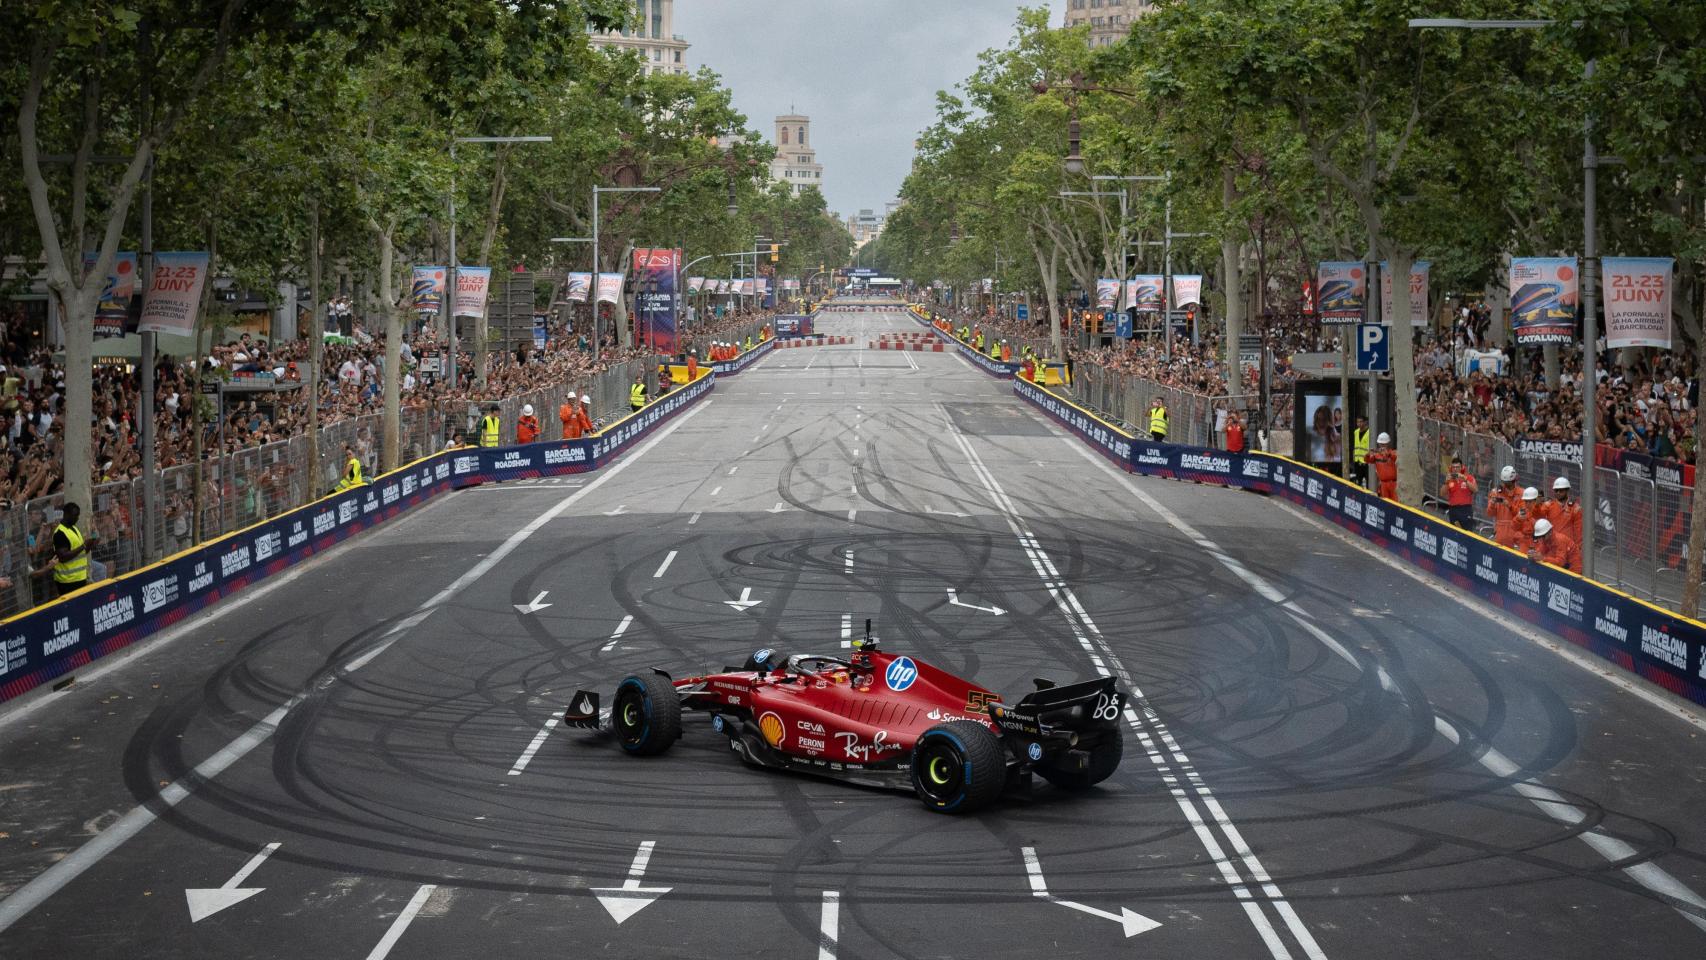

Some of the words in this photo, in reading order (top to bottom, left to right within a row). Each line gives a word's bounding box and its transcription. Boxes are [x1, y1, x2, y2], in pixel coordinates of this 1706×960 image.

[150, 279, 194, 292] JUNY
[1612, 288, 1664, 302] JUNY
[1119, 314, 1128, 326] P
[1363, 326, 1383, 351] P
[1517, 327, 1572, 336] BARCELONA
[1518, 335, 1572, 343] CATALUNYA
[545, 448, 585, 459] BARCELONA
[1146, 448, 1160, 456] LIVE
[1520, 440, 1583, 455] BARCELON
[495, 459, 530, 469] ROADSHOW
[1138, 455, 1168, 465] ROADSHOW
[1181, 454, 1230, 467] BARCELONA
[221, 546, 249, 568] BARCELONA
[194, 562, 205, 576] LIVE
[1476, 564, 1498, 584] ROADSHOW
[188, 571, 213, 593] ROADSHOW
[1508, 568, 1540, 594] BARCELONA
[93, 595, 134, 625] BARCELONA
[1606, 605, 1618, 623] LIVE
[54, 617, 69, 635] LIVE
[1595, 617, 1628, 642] ROADSHOW
[43, 628, 80, 656] ROADSHOW
[1642, 624, 1687, 660] BARCELONA
[889, 657, 915, 690] hp
[964, 690, 999, 716] 55
[1004, 711, 1034, 721] V-Power
[798, 736, 824, 748] PERONI
[834, 730, 902, 760] Ray-Ban
[1030, 744, 1041, 759] hp
